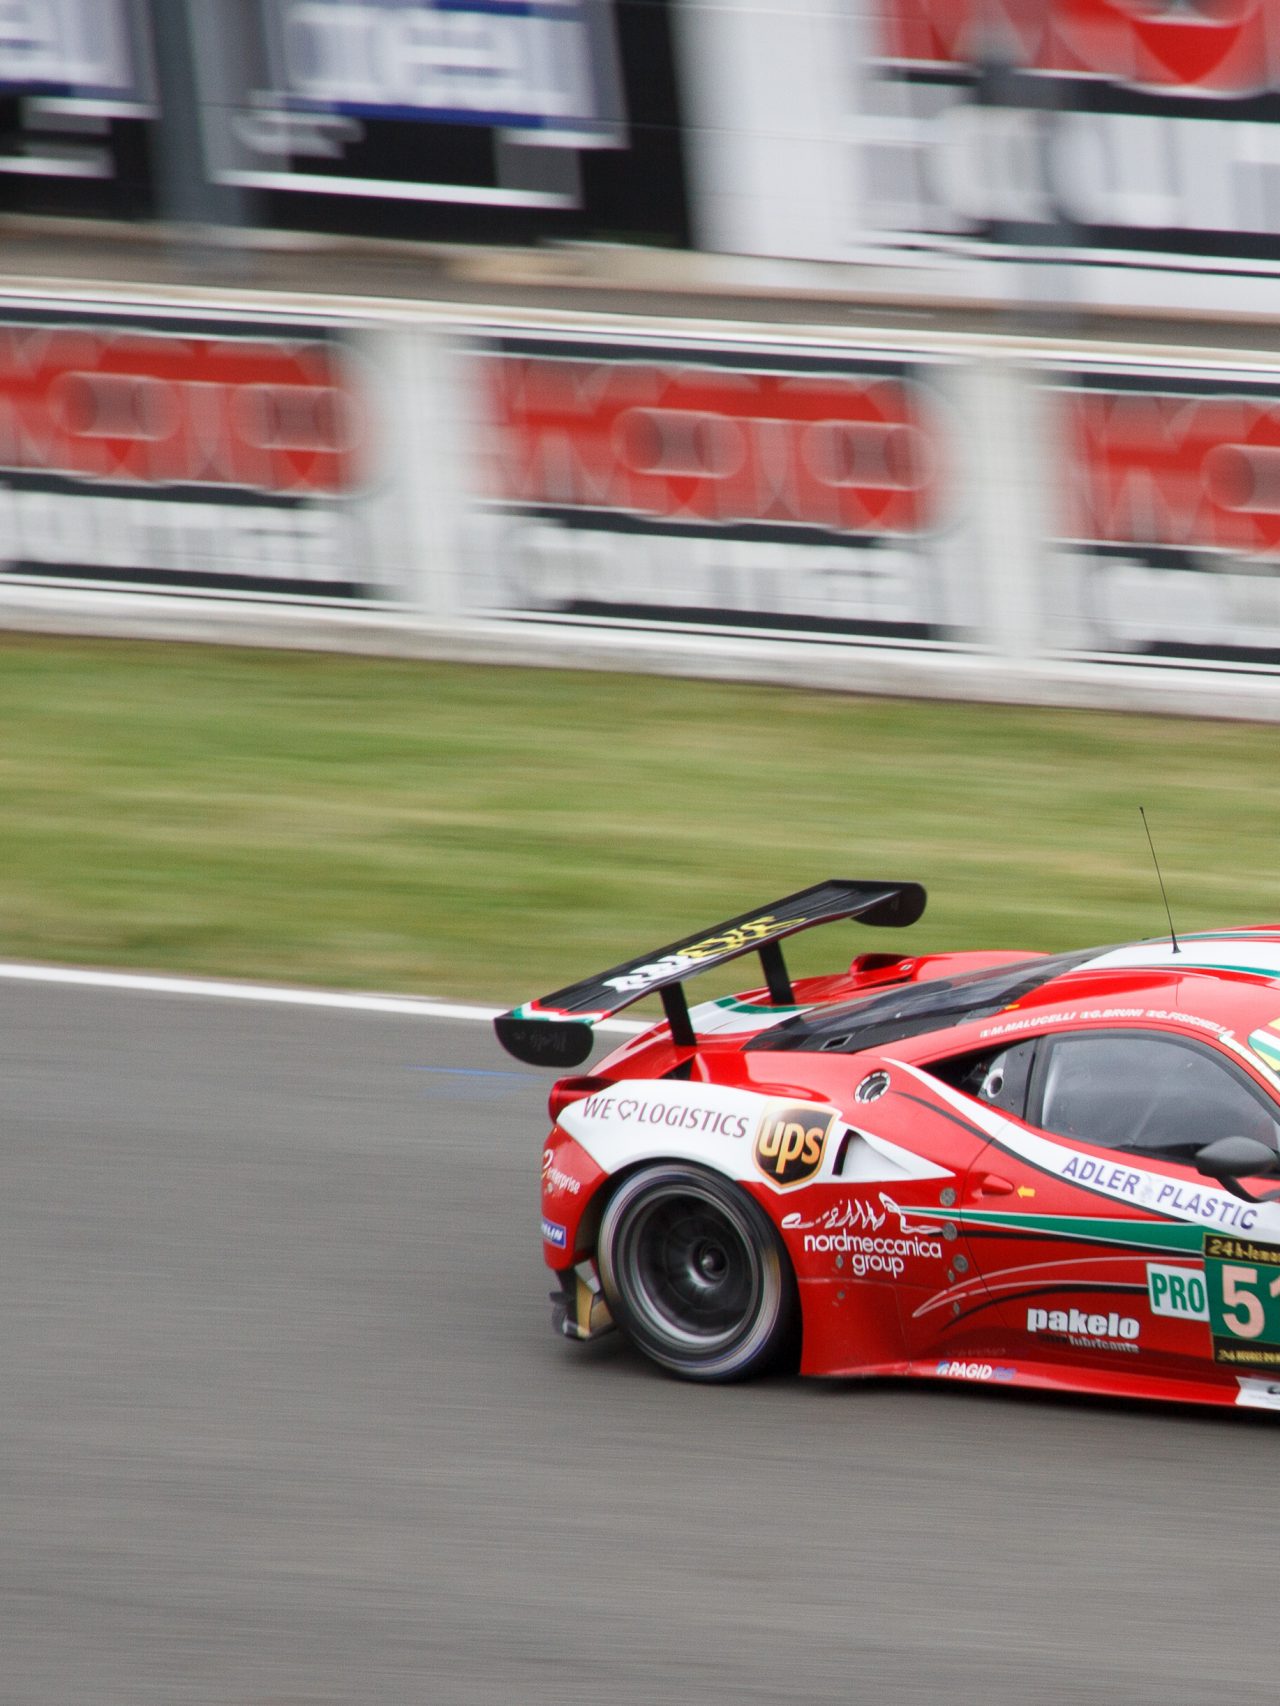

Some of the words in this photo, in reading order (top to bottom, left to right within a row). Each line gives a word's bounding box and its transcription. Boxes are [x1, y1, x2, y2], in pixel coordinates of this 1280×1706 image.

[582, 1097, 616, 1119] WE
[637, 1102, 750, 1138] LOGISTICS
[758, 1117, 825, 1175] ups
[1062, 1156, 1141, 1195] ADLER
[1156, 1184, 1259, 1231] PLASTIC
[804, 1227, 943, 1258] nordmeccanica
[852, 1253, 905, 1279] group
[1150, 1272, 1206, 1314] PRO
[1026, 1307, 1140, 1339] pakelo
[948, 1361, 993, 1380] PAGID
